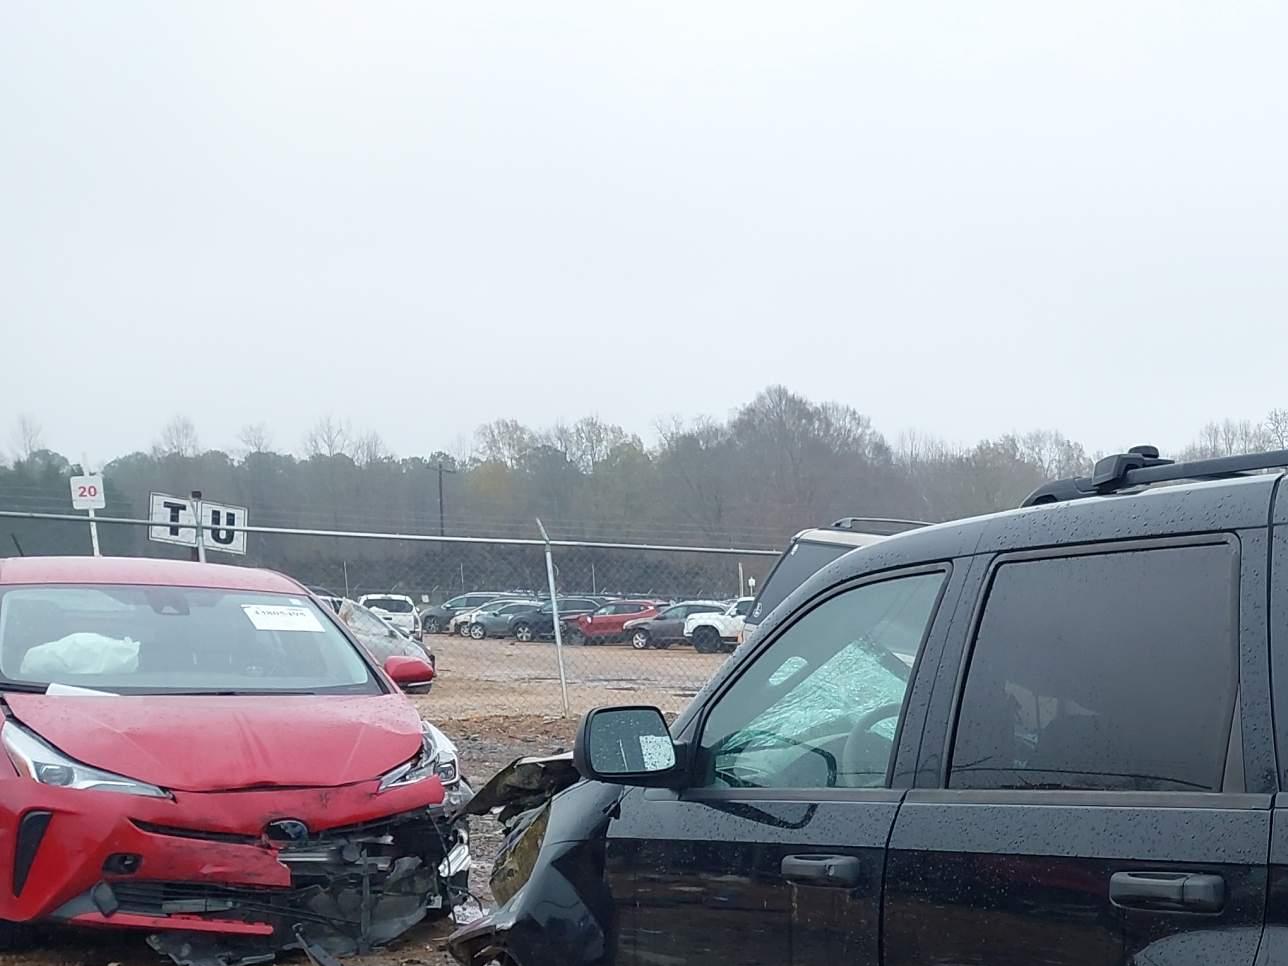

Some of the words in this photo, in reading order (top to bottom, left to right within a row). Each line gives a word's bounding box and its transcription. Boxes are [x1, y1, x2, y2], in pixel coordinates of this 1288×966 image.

[78, 486, 97, 498] 20
[163, 501, 187, 537] T
[211, 509, 236, 545] U
